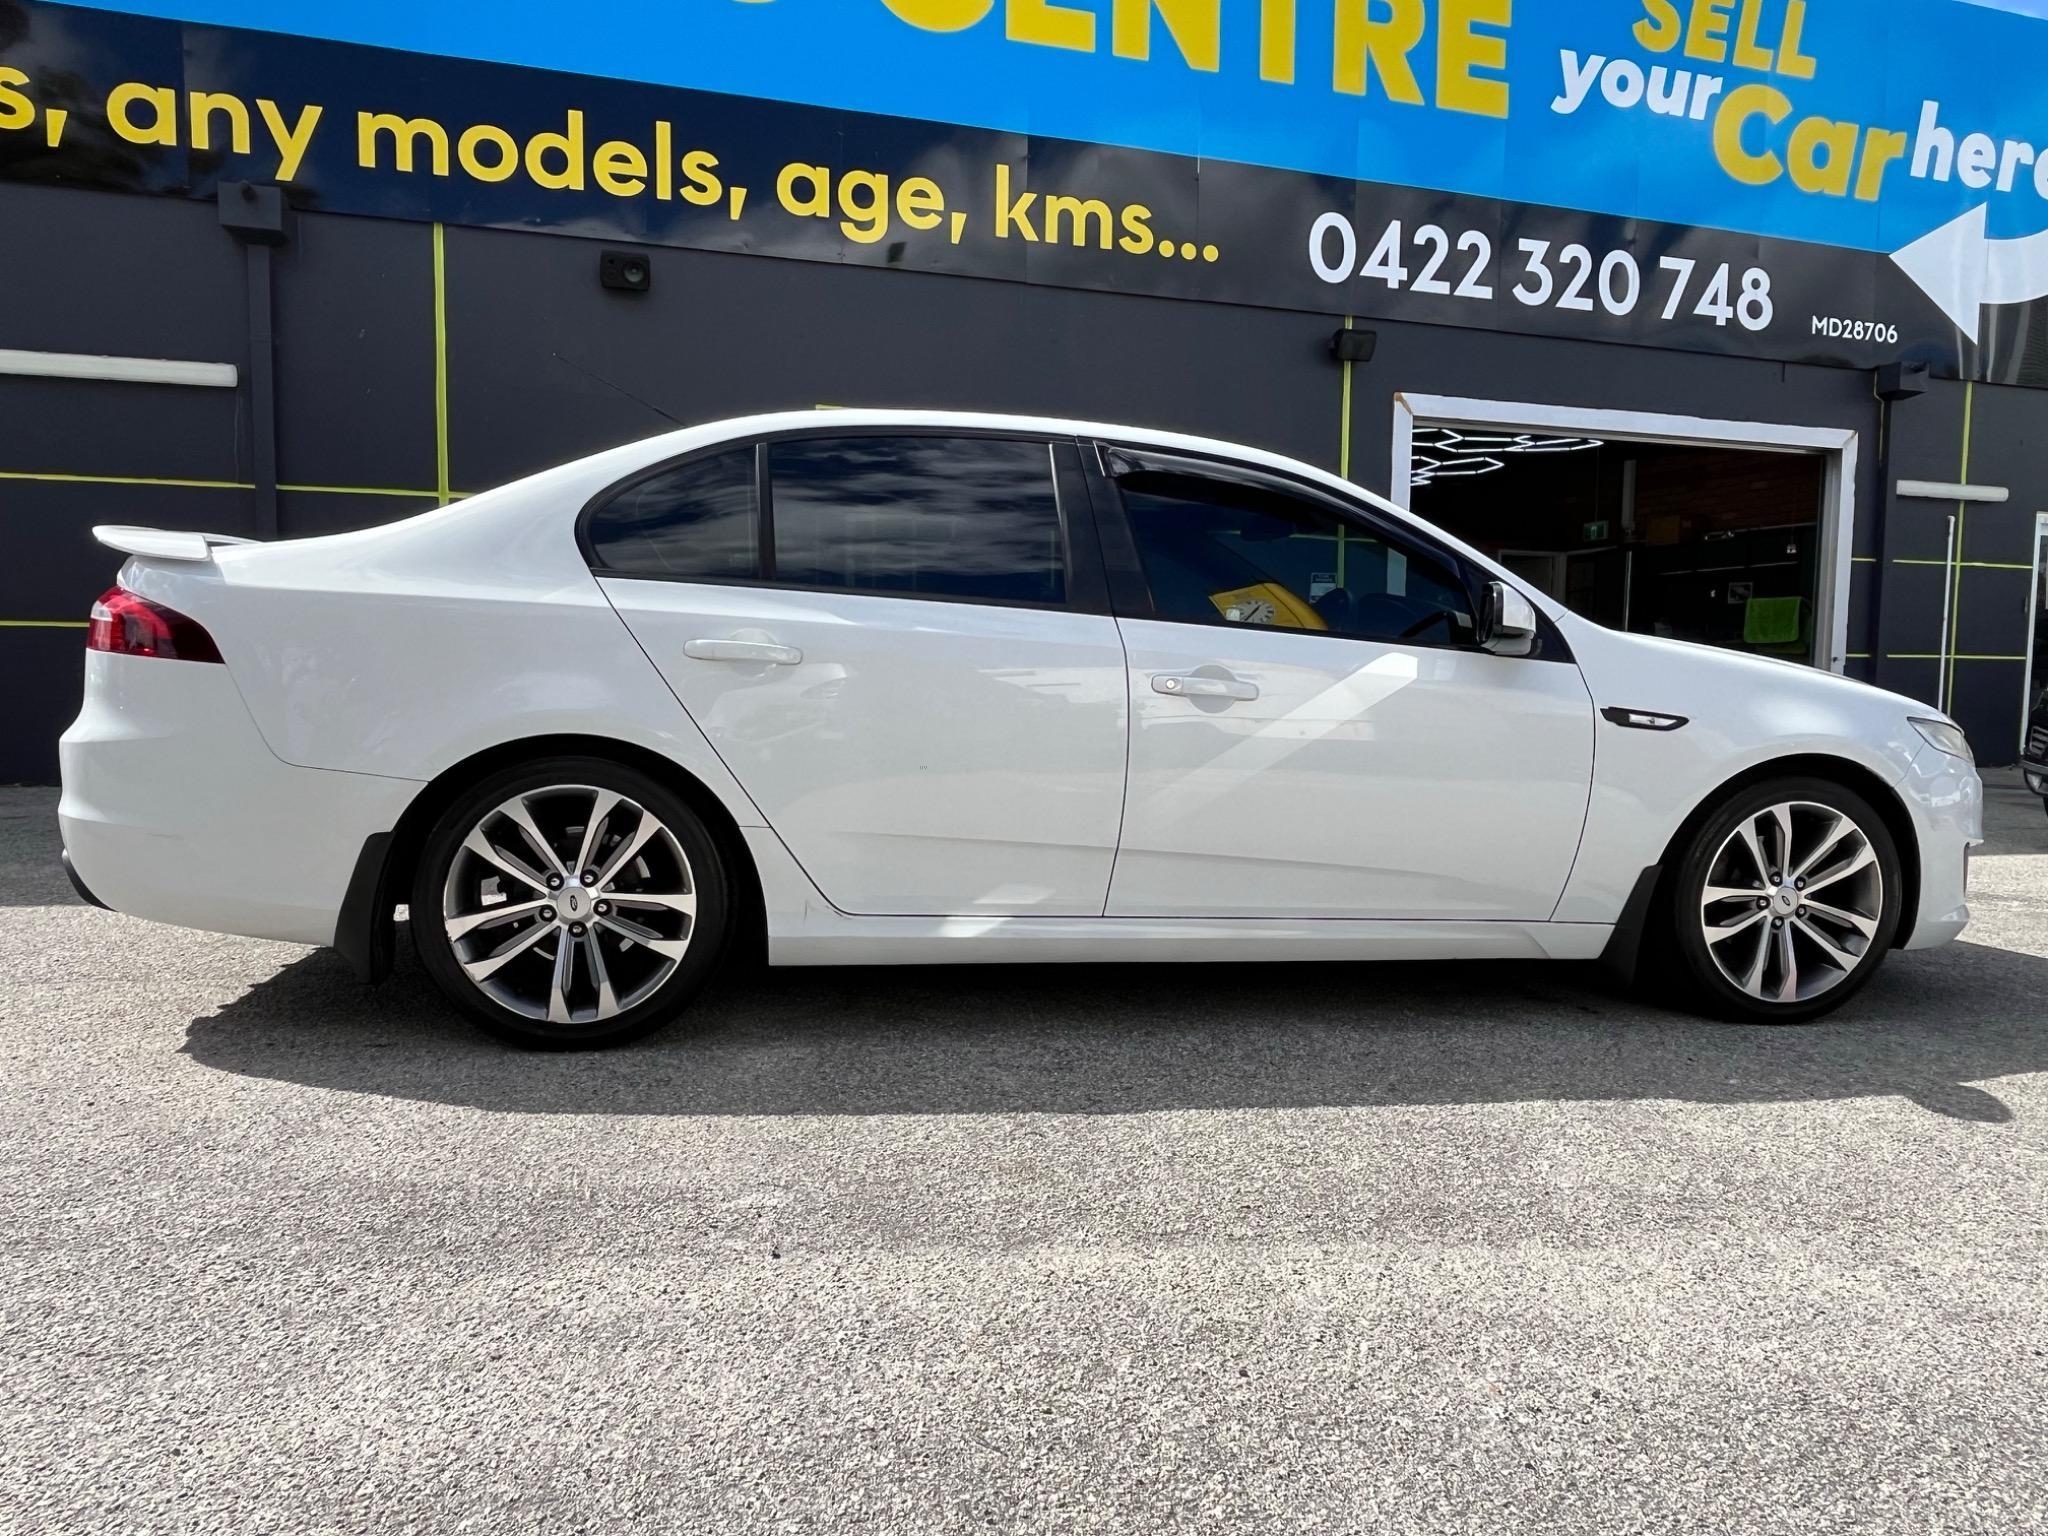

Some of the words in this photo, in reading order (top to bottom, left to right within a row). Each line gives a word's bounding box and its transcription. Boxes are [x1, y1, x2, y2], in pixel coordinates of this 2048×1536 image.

[883, 0, 1511, 118] NTRE
[1632, 0, 1816, 79] SELL
[106, 82, 323, 182] any
[357, 109, 748, 222] models,
[776, 161, 967, 244] age,
[995, 164, 1219, 263] kms...
[1550, 49, 1723, 121] your
[1713, 84, 1907, 201] Car
[1308, 211, 1493, 300] 0422
[1512, 237, 1640, 316] 320
[1658, 255, 1774, 331] 748
[1811, 315, 1898, 344] MD28706
